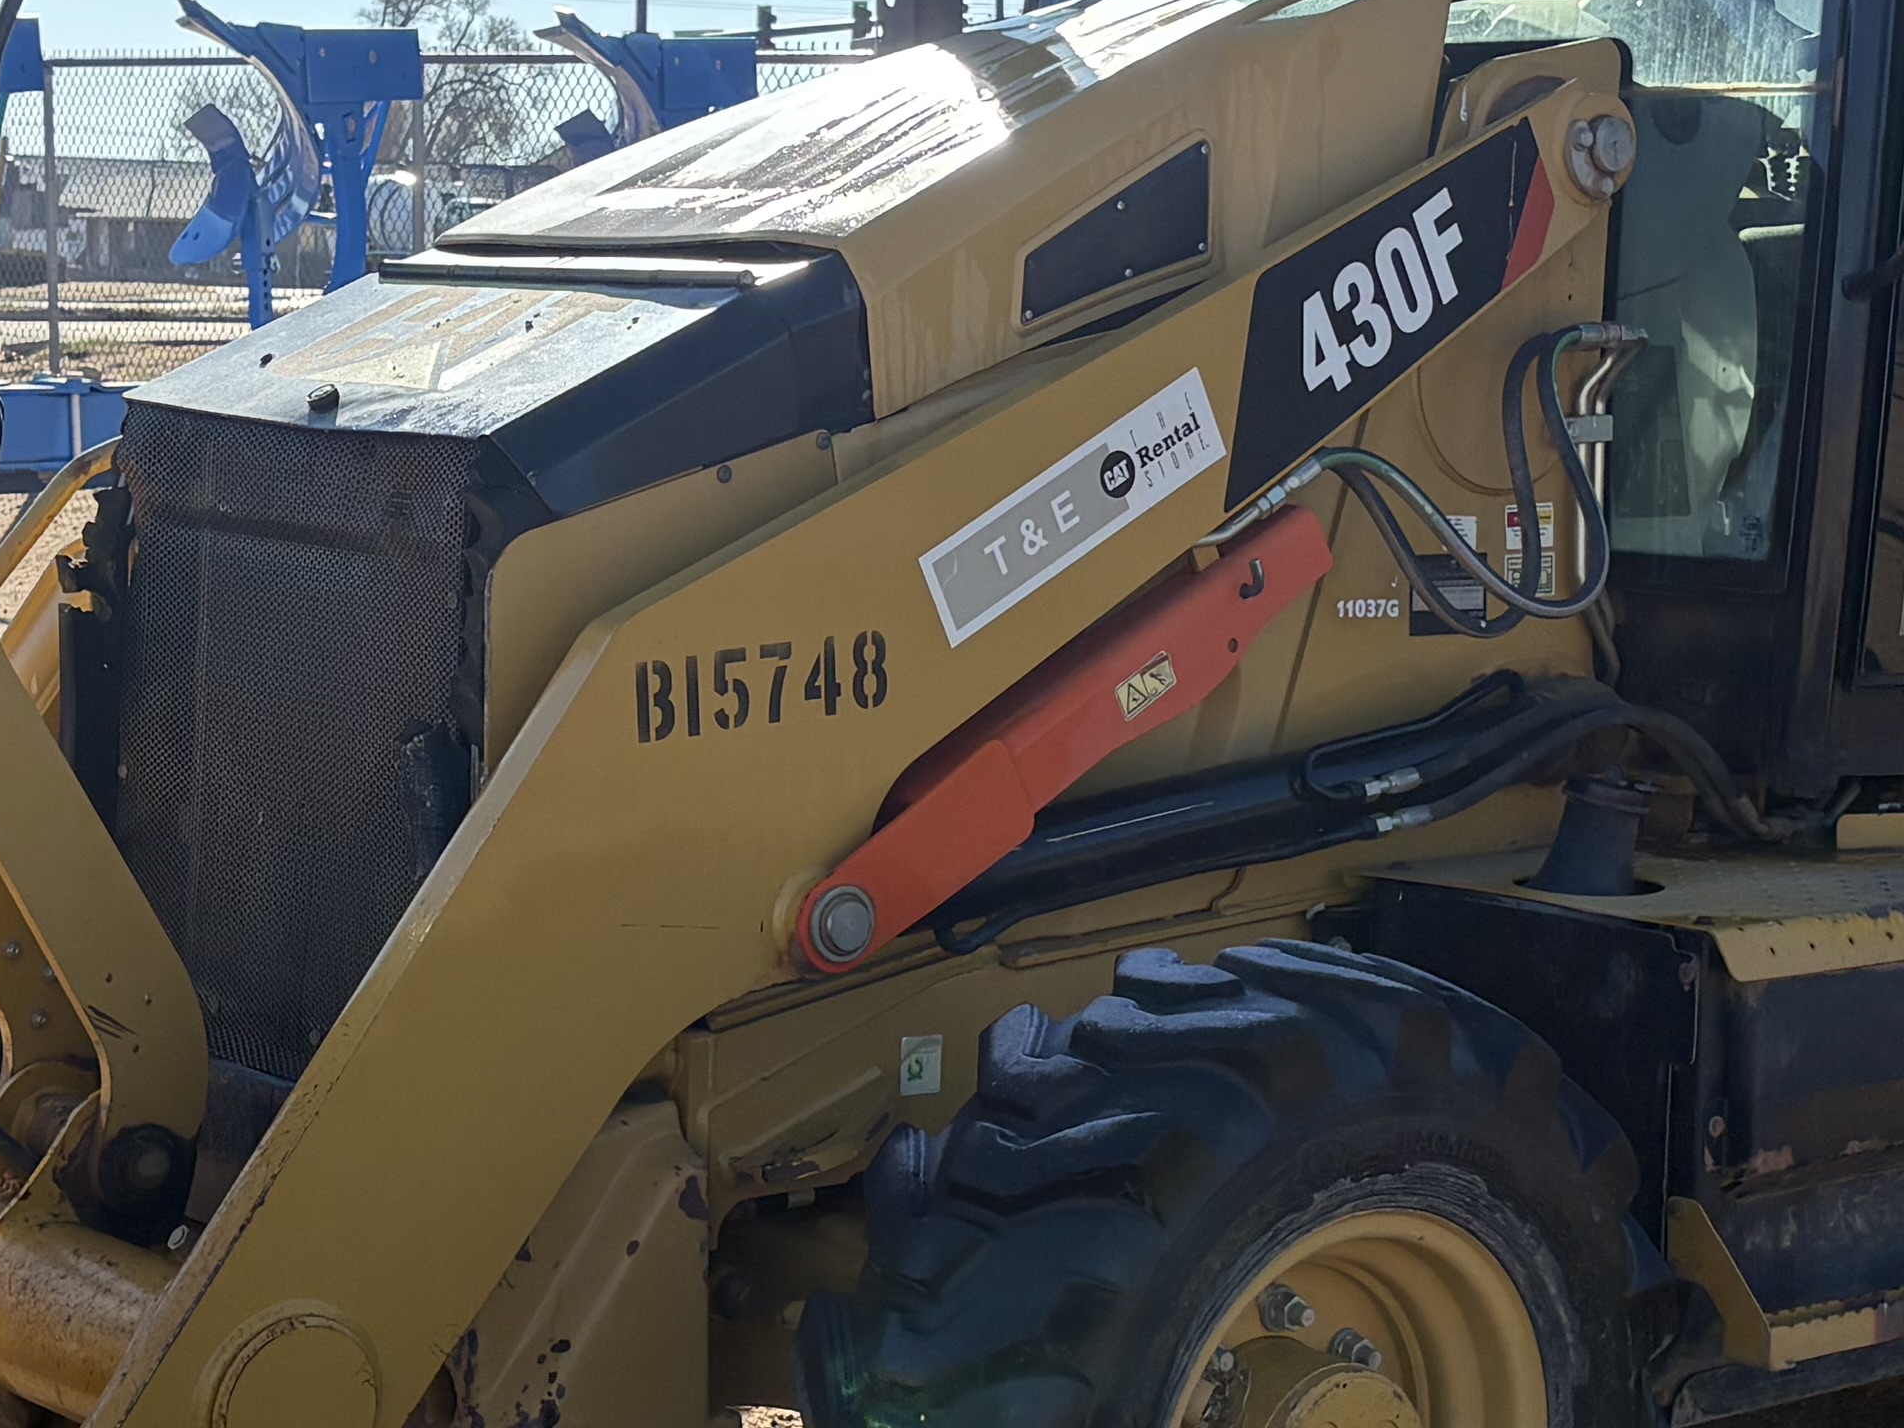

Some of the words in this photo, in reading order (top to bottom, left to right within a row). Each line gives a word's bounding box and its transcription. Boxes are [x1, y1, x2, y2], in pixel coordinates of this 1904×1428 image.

[1303, 186, 1463, 392] 430F
[271, 288, 634, 391] CAT
[1135, 411, 1201, 469] Rental
[1103, 458, 1130, 491] CAT
[1337, 599, 1400, 618] 11037G
